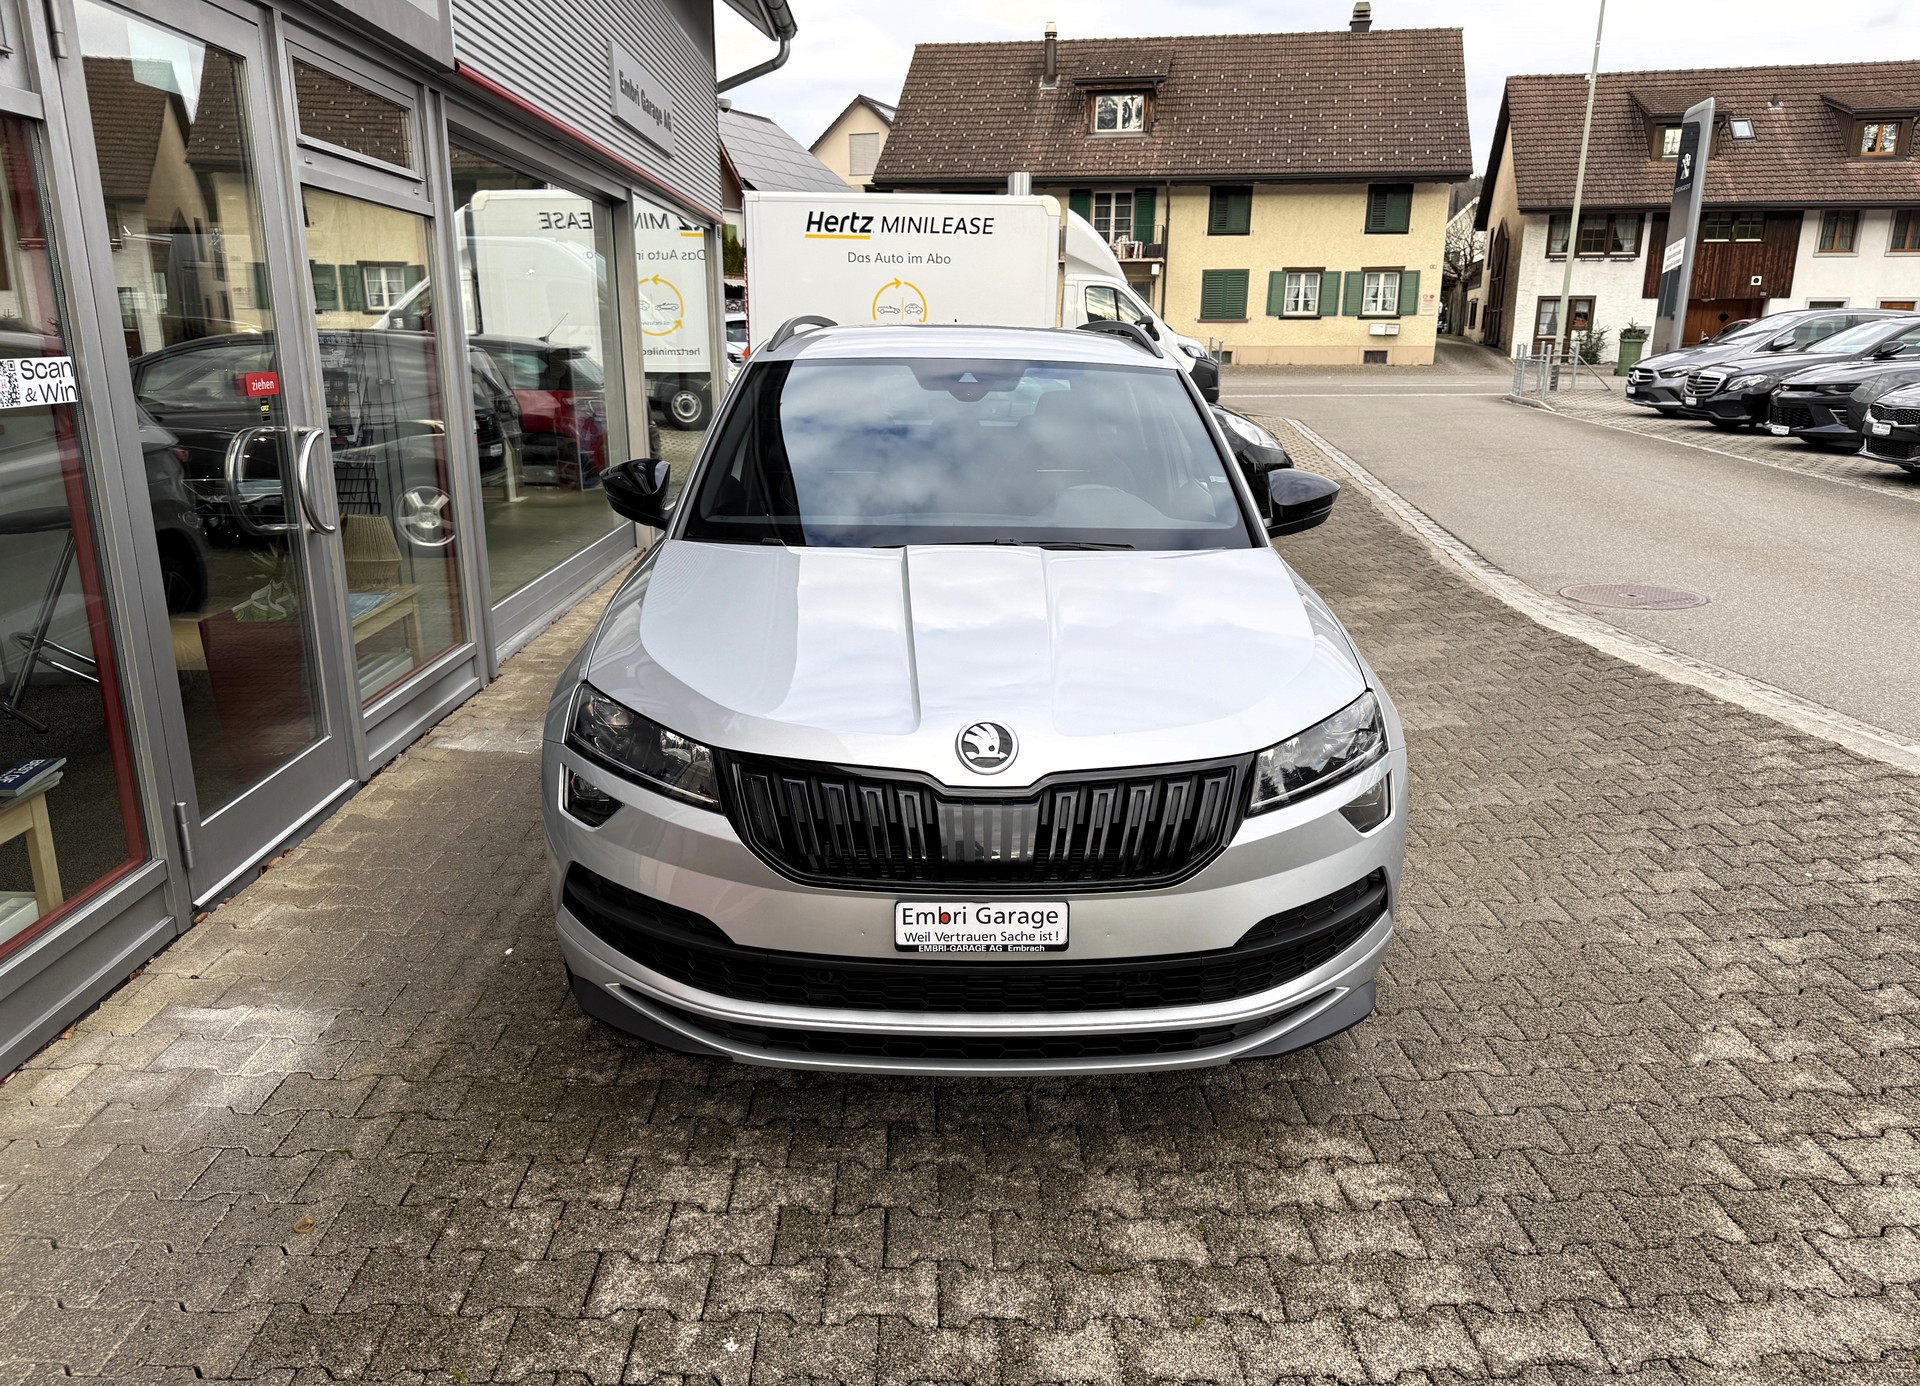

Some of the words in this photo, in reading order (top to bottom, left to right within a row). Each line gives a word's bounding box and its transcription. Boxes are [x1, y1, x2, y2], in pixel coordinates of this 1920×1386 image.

[618, 69, 640, 106] Embri
[641, 89, 663, 127] Garage
[663, 109, 672, 132] AG
[805, 211, 874, 233] Hertz
[880, 216, 995, 235] MINILEASE
[847, 252, 871, 264] Das
[874, 252, 904, 264] Auto
[907, 253, 923, 264] im
[926, 253, 951, 265] Abo
[20, 359, 74, 380] Scan
[25, 387, 38, 403] &
[38, 379, 78, 403] Win
[251, 378, 275, 391] ziehen
[902, 906, 967, 925] Embri
[975, 906, 1059, 929] Garage
[904, 931, 931, 942] Weil
[934, 931, 997, 942] Vertrauen
[1000, 931, 1036, 942] Sache
[918, 944, 987, 952] EMBRI-GARAGE
[989, 944, 1003, 952] AG
[1007, 944, 1045, 952] Embrach
